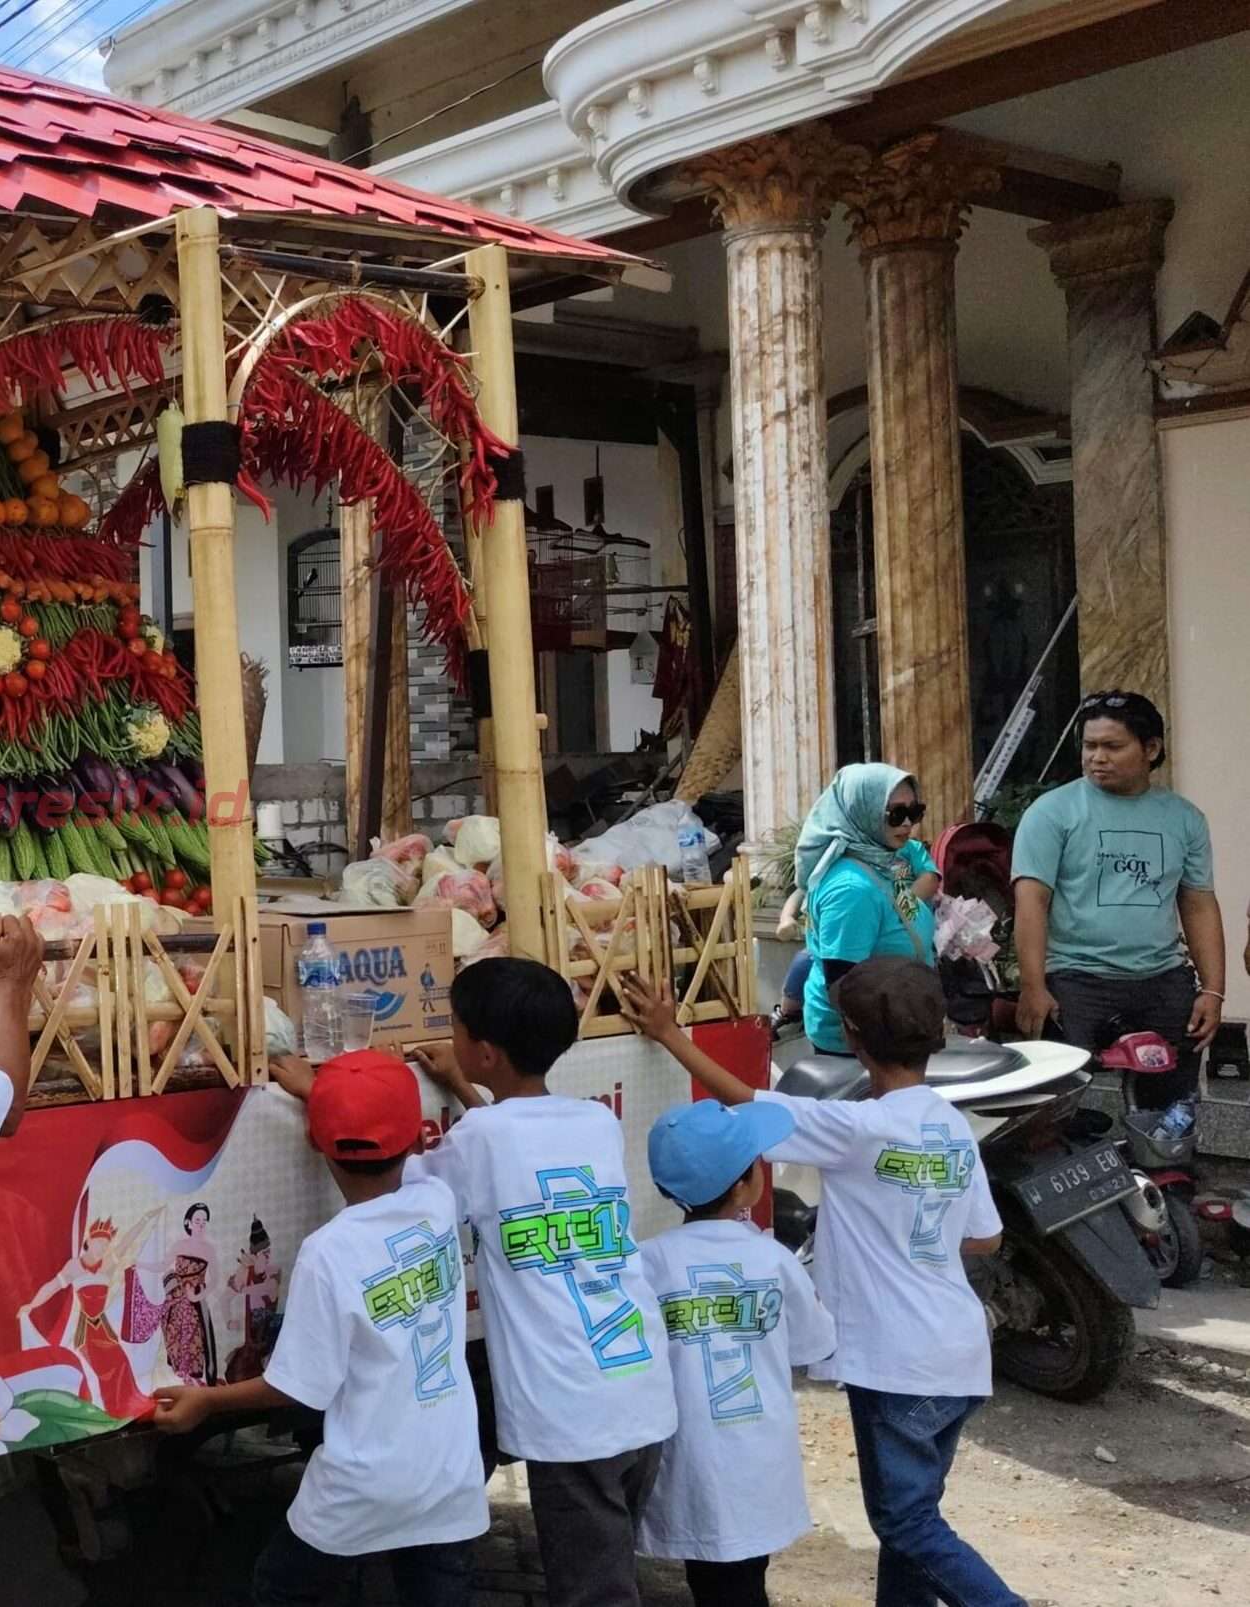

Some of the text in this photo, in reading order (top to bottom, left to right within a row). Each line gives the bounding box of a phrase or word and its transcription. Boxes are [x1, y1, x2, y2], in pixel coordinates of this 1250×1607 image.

[1114, 859, 1150, 873] GOT
[338, 946, 407, 985] AQUA
[1029, 1185, 1043, 1205] W
[1050, 1164, 1090, 1193] 6139
